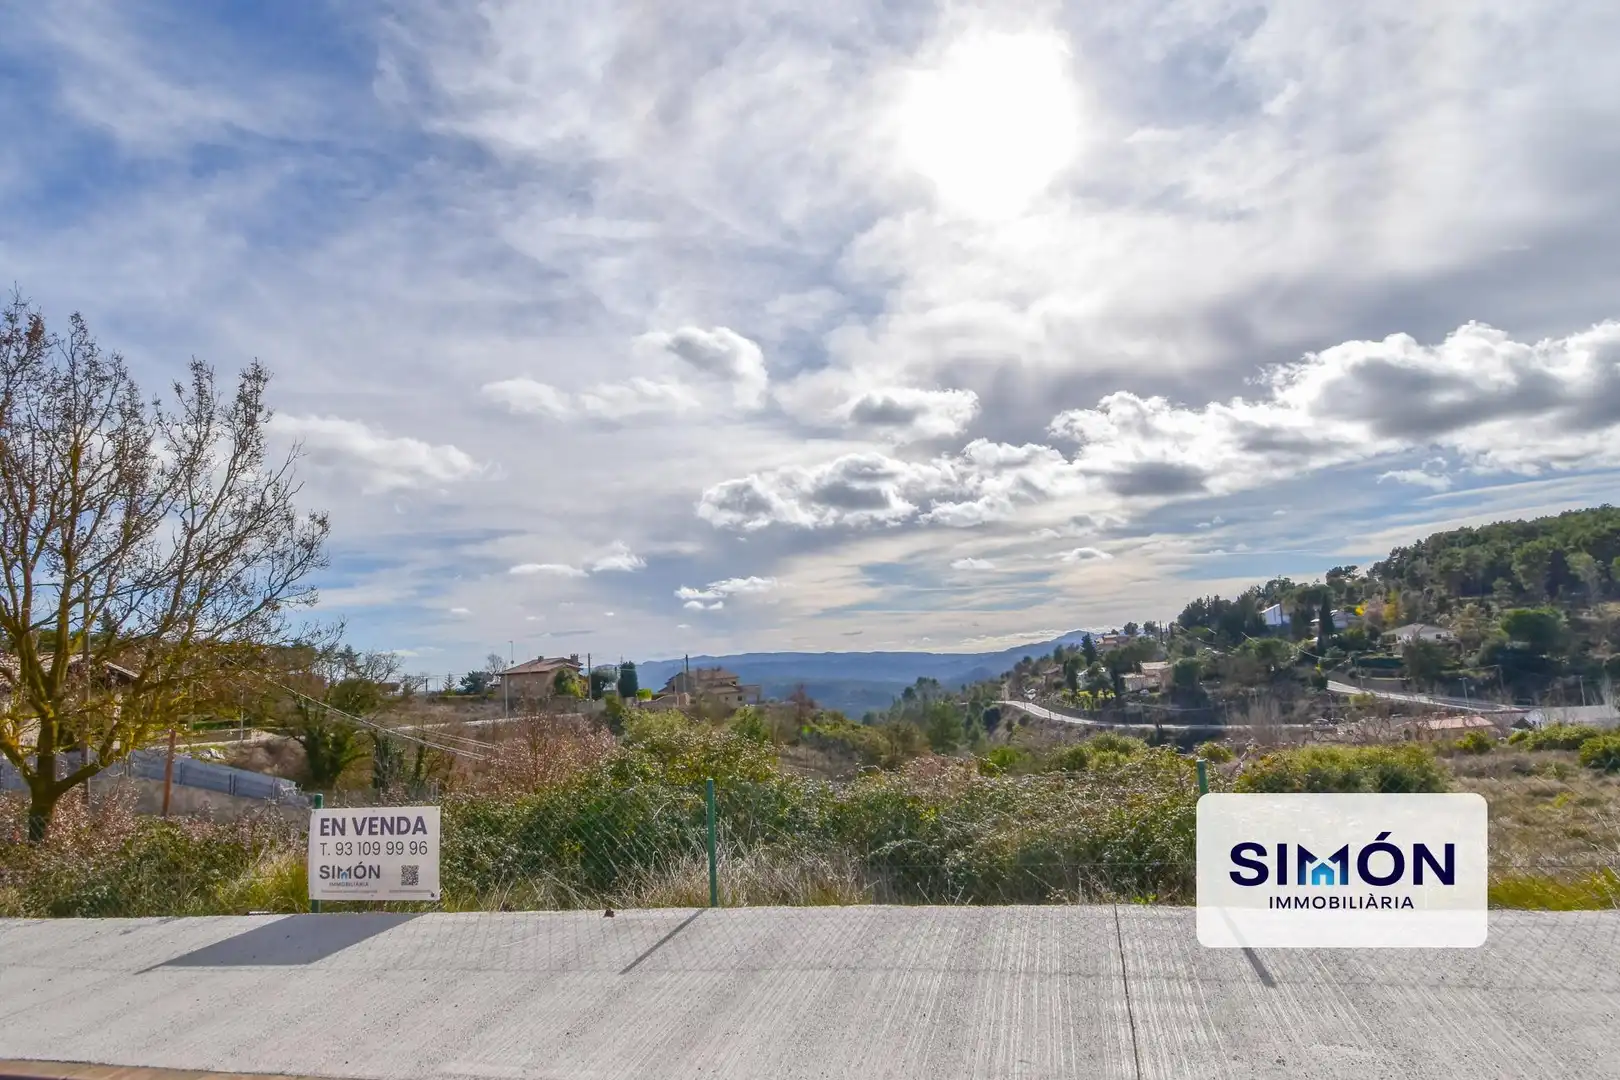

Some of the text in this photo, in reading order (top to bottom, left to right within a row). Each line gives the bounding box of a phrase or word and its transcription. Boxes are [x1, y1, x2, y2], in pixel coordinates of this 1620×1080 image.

[320, 816, 428, 836] EN VENDA
[320, 840, 428, 856] T. 93 109 99 96
[319, 861, 381, 880] SIMÓN
